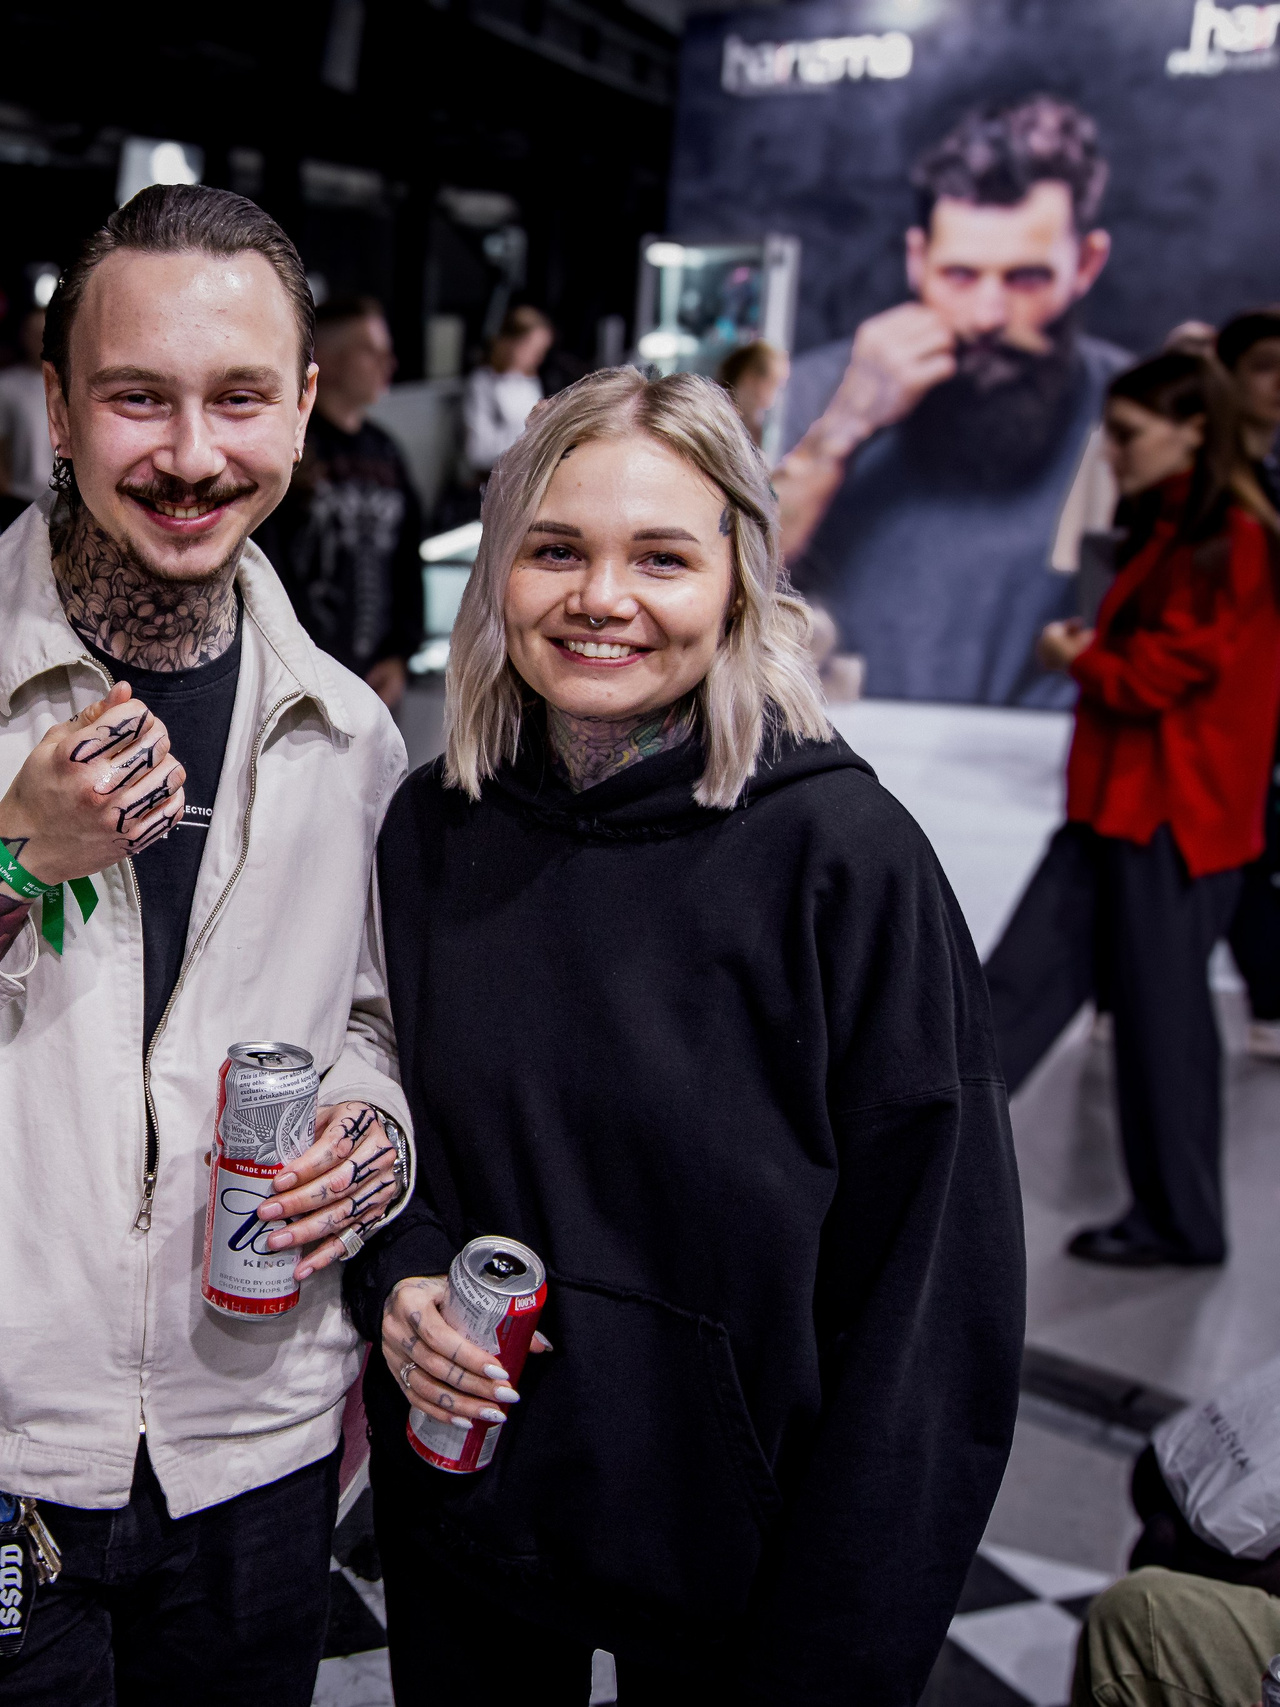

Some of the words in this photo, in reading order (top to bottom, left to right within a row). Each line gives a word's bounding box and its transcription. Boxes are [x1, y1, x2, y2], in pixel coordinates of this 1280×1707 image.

[184, 804, 212, 817] ECTIO
[258, 1089, 295, 1100] drinkability
[295, 1086, 305, 1094] you
[235, 1163, 259, 1174] TRADE
[243, 1259, 286, 1269] KING
[219, 1272, 251, 1285] BREWED
[218, 1280, 257, 1293] CHOICEST
